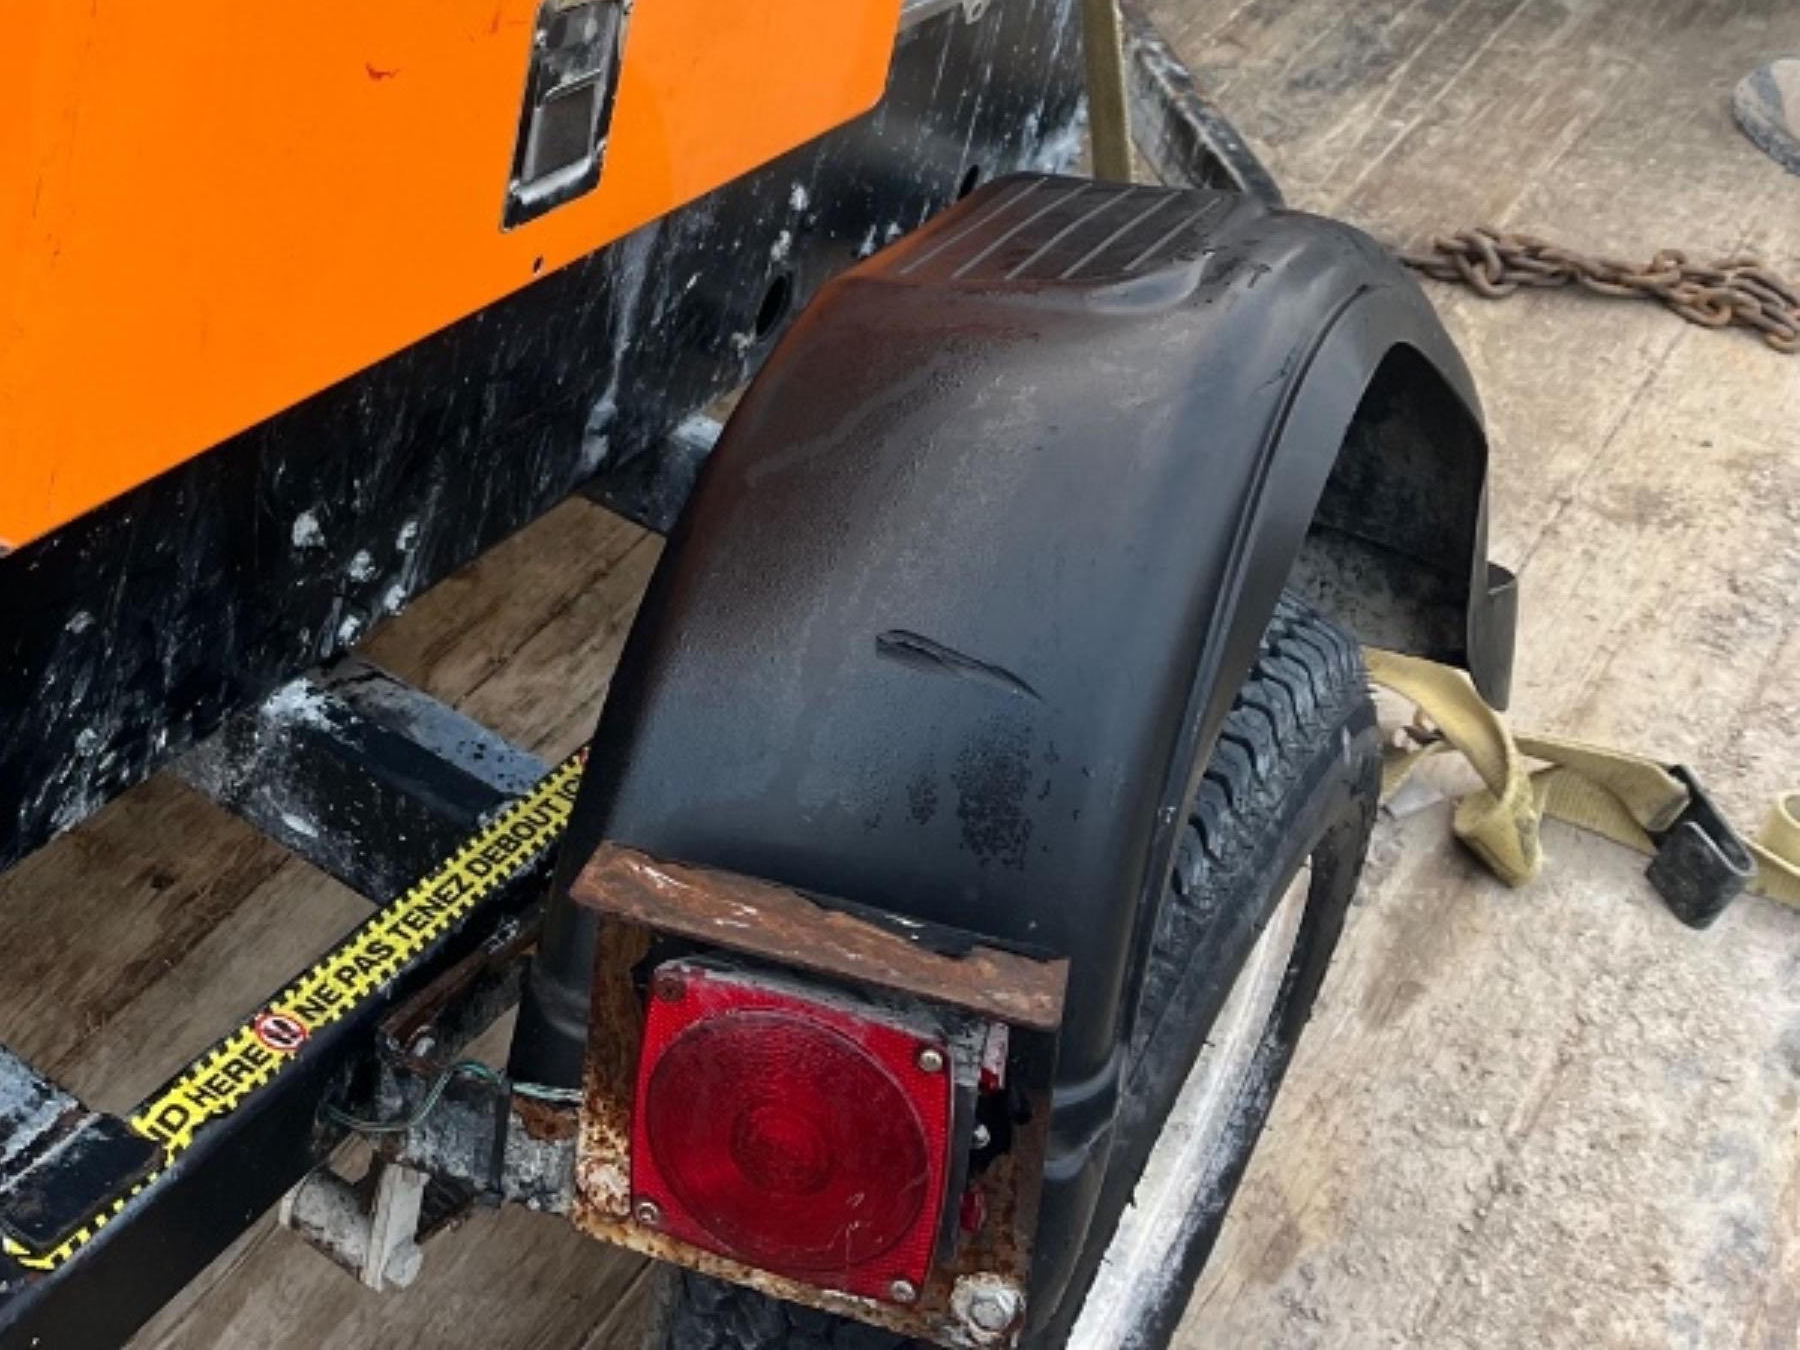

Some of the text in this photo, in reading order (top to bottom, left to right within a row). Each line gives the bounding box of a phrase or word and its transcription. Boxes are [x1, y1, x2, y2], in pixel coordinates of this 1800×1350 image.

[292, 777, 583, 1022] NE PAS TENEZ DEBOUT IC
[182, 1042, 274, 1107] HERE
